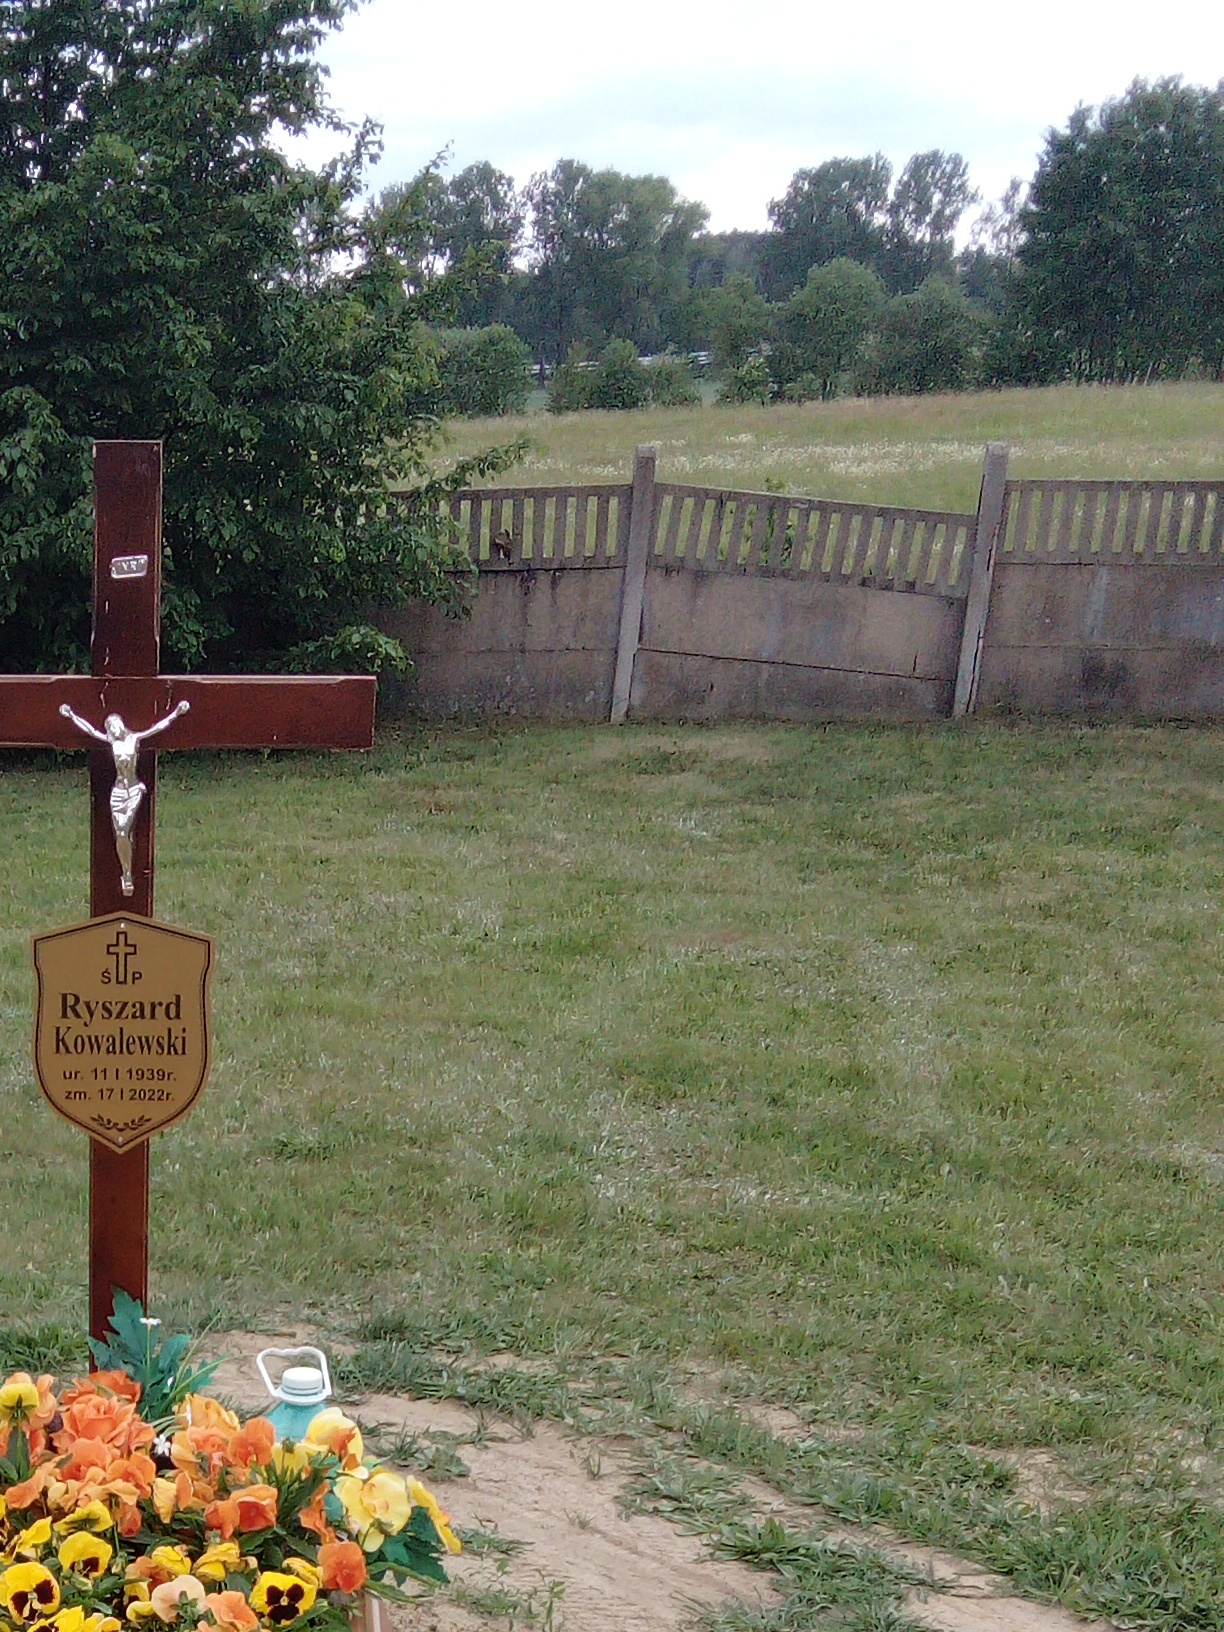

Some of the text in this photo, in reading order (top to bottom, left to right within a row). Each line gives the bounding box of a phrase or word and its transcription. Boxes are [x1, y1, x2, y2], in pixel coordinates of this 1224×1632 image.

[100, 967, 143, 985] Ś P
[58, 992, 182, 1027] Ryszard
[54, 1025, 187, 1056] Kowalewski
[62, 1069, 84, 1081] ur.
[91, 1067, 108, 1081] 11
[126, 1067, 177, 1082] 1939r.
[64, 1090, 92, 1101] zm.
[97, 1088, 115, 1101] 17
[128, 1088, 175, 1101] 2022r.
